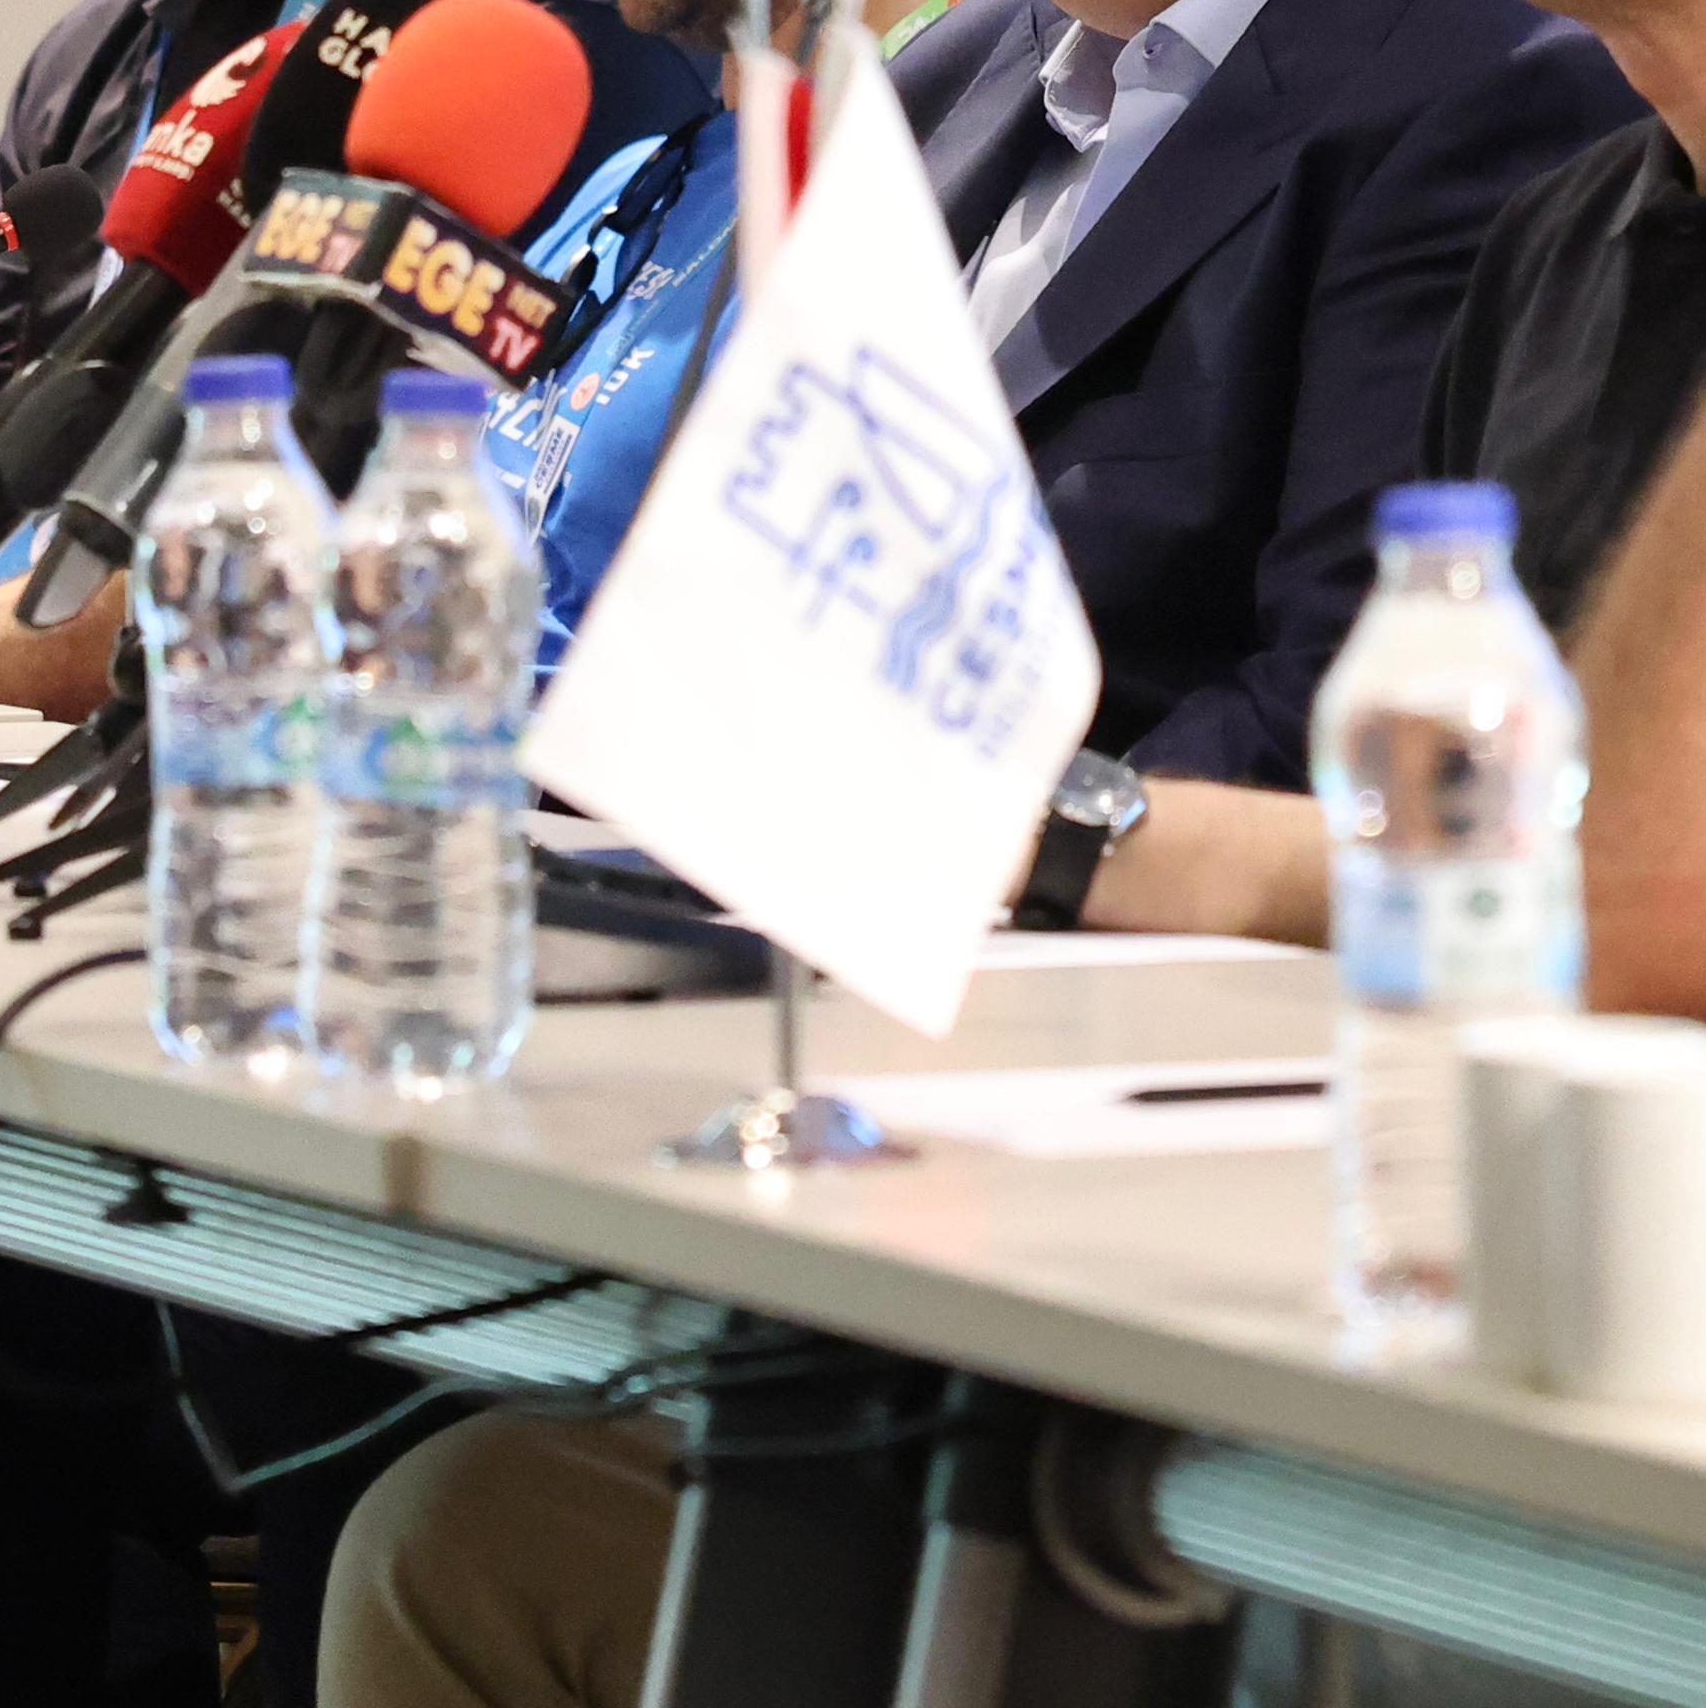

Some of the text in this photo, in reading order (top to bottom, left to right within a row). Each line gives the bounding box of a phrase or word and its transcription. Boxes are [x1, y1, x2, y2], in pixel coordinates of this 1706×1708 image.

[332, 6, 391, 57] HA
[142, 107, 215, 168] nka
[382, 215, 506, 338] EGE
[488, 315, 543, 373] TV
